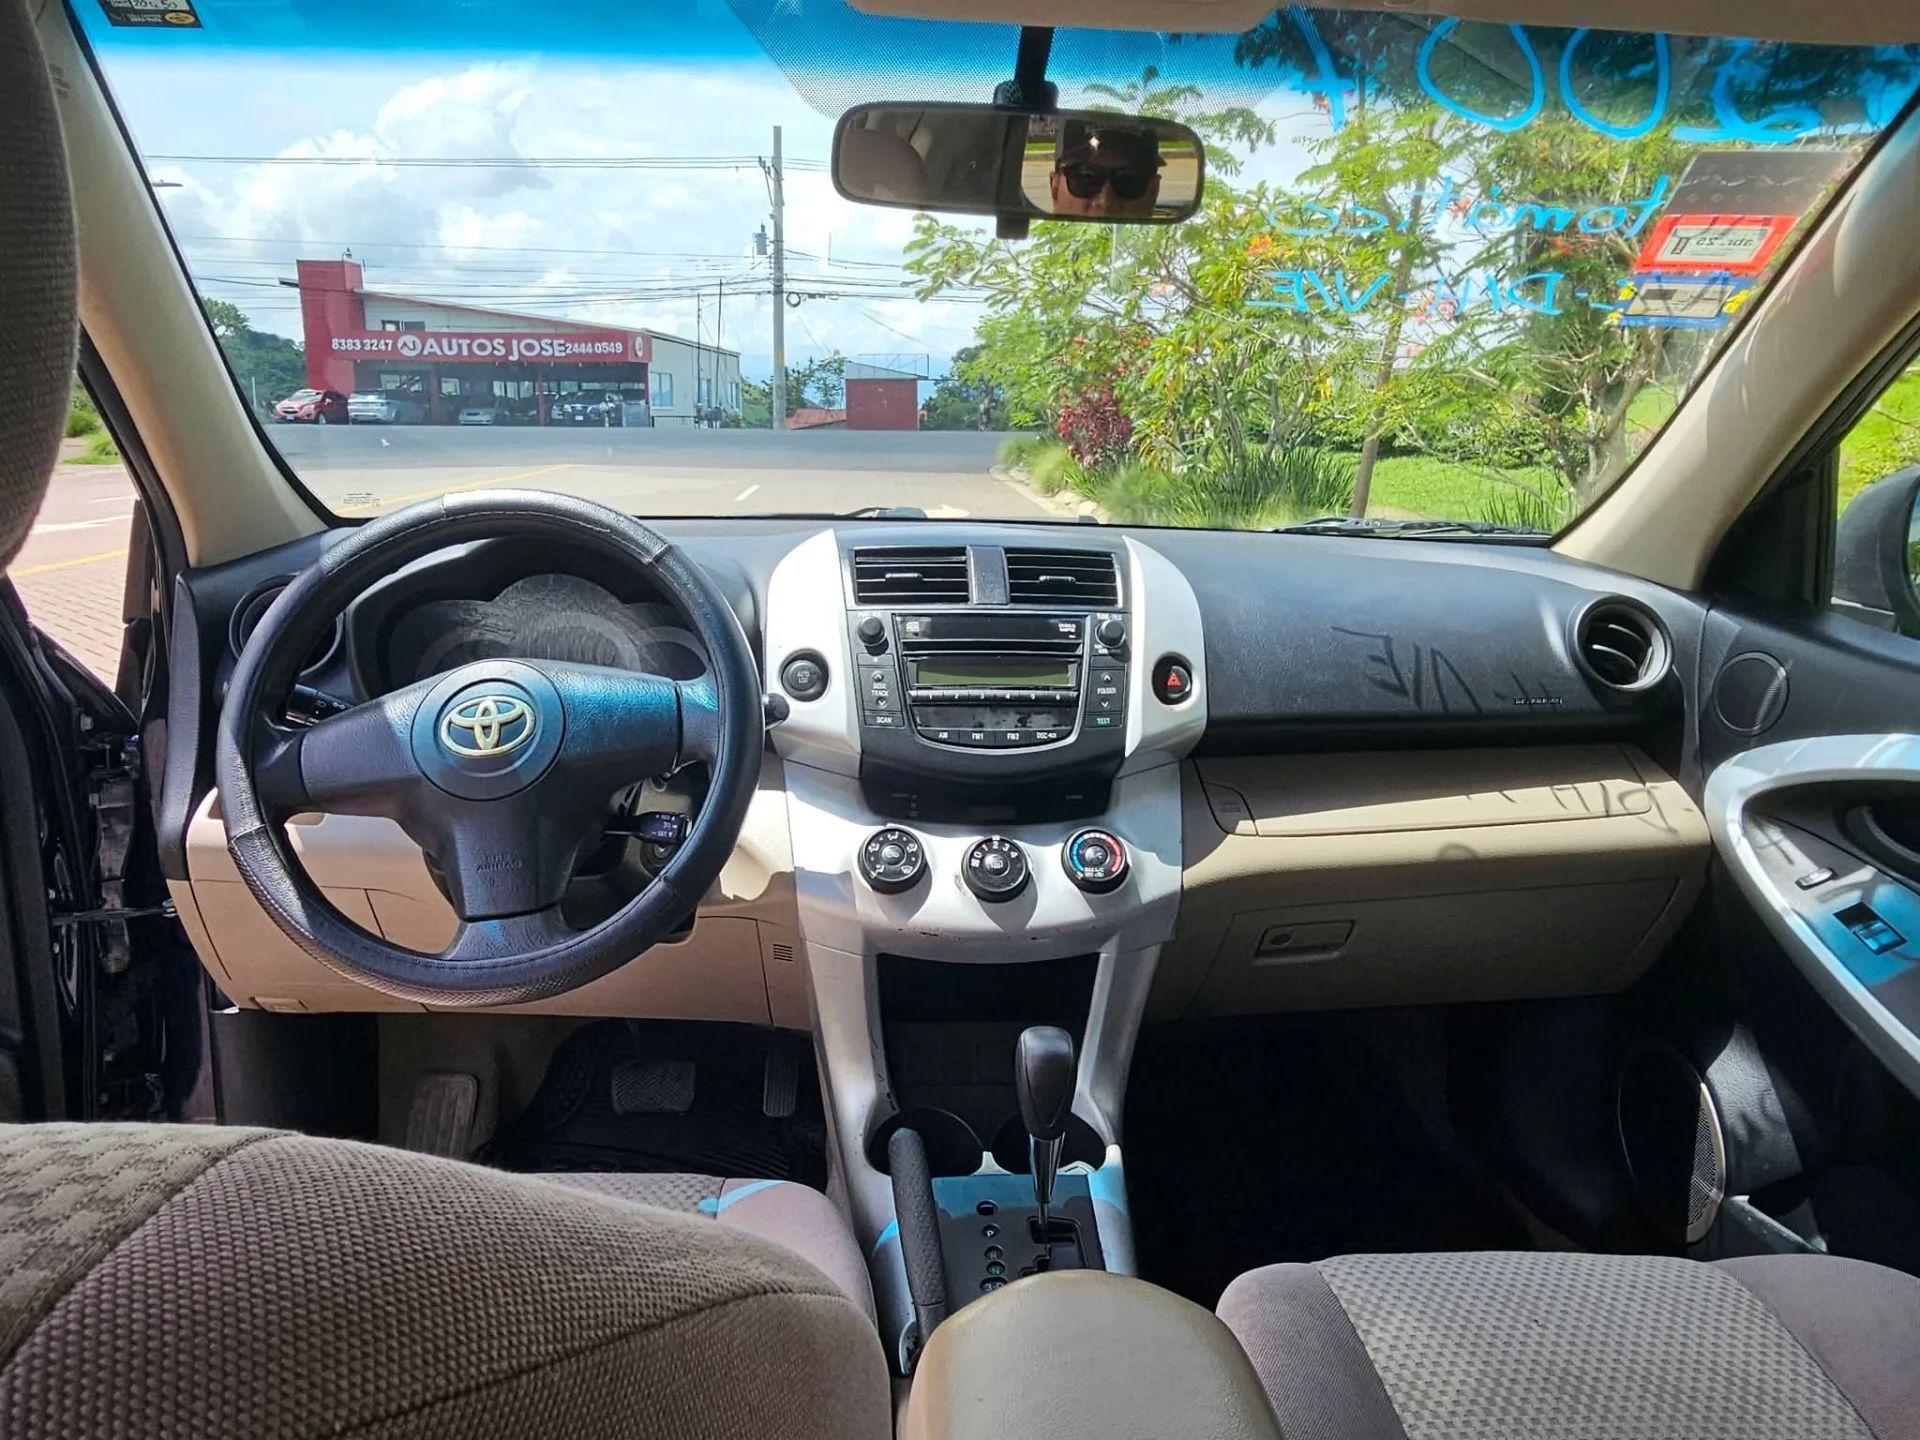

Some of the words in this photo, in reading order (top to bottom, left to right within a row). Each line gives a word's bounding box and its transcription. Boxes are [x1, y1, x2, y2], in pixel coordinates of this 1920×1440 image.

[332, 338, 361, 350] 8383
[364, 339, 393, 351] 3247
[423, 338, 506, 356] AUTOS
[508, 338, 566, 361] JOSE
[565, 343, 593, 354] 2444
[595, 342, 623, 354] 0549
[992, 841, 999, 849] 2
[1002, 843, 1010, 851] 3
